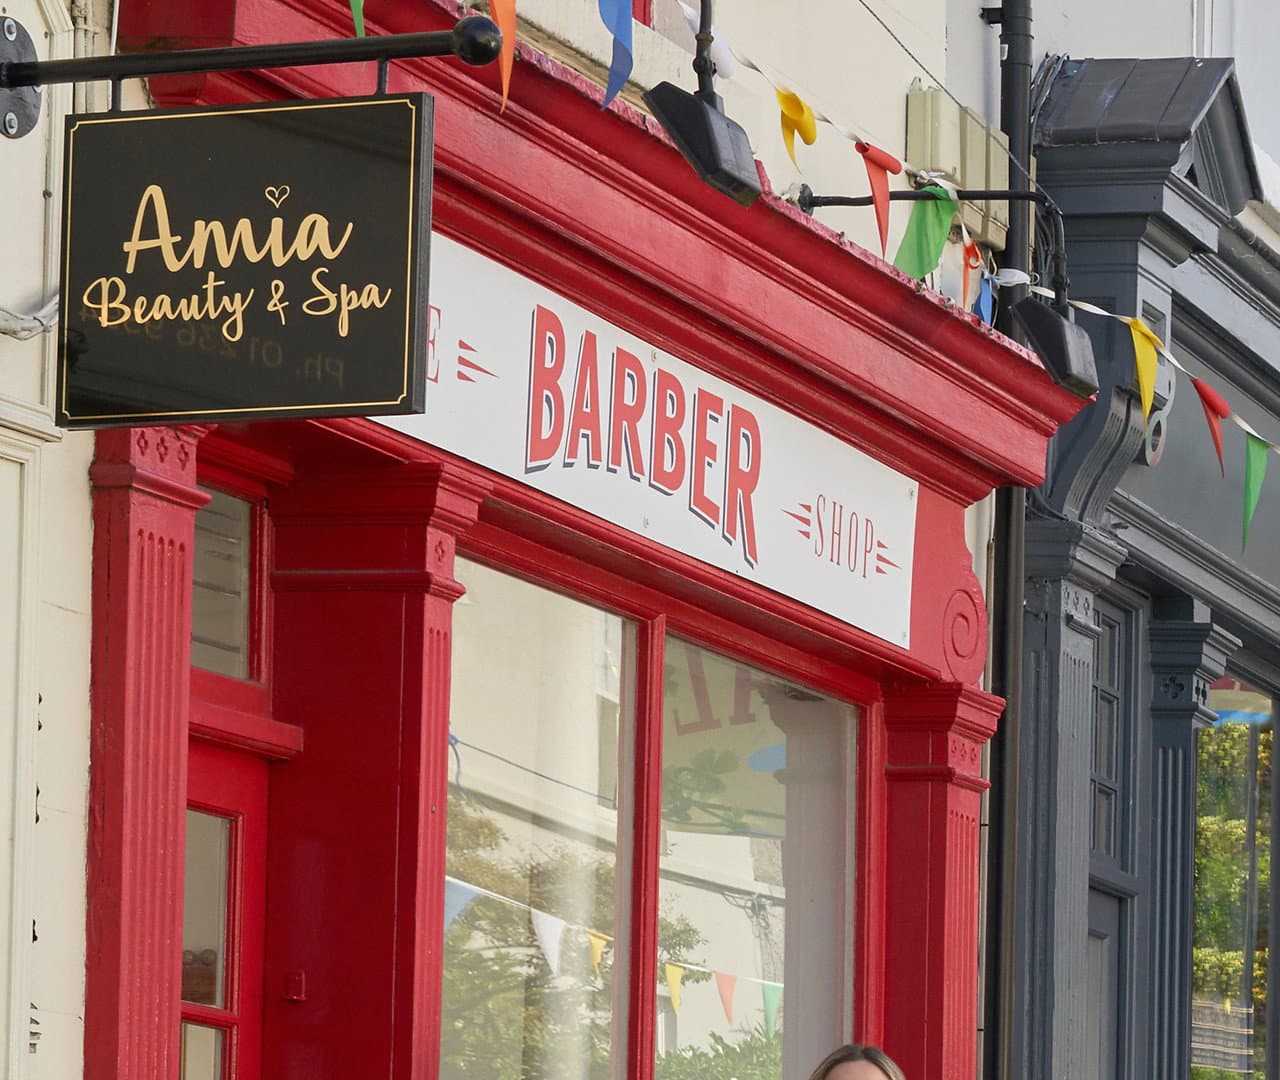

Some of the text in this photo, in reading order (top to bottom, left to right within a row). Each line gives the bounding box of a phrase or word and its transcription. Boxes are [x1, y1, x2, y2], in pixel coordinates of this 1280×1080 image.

[123, 184, 354, 274] Amia
[83, 271, 254, 342] Beauty
[266, 279, 288, 326] &
[302, 267, 392, 337] Spa
[524, 304, 762, 571] BARBER
[814, 493, 875, 579] SHOP
